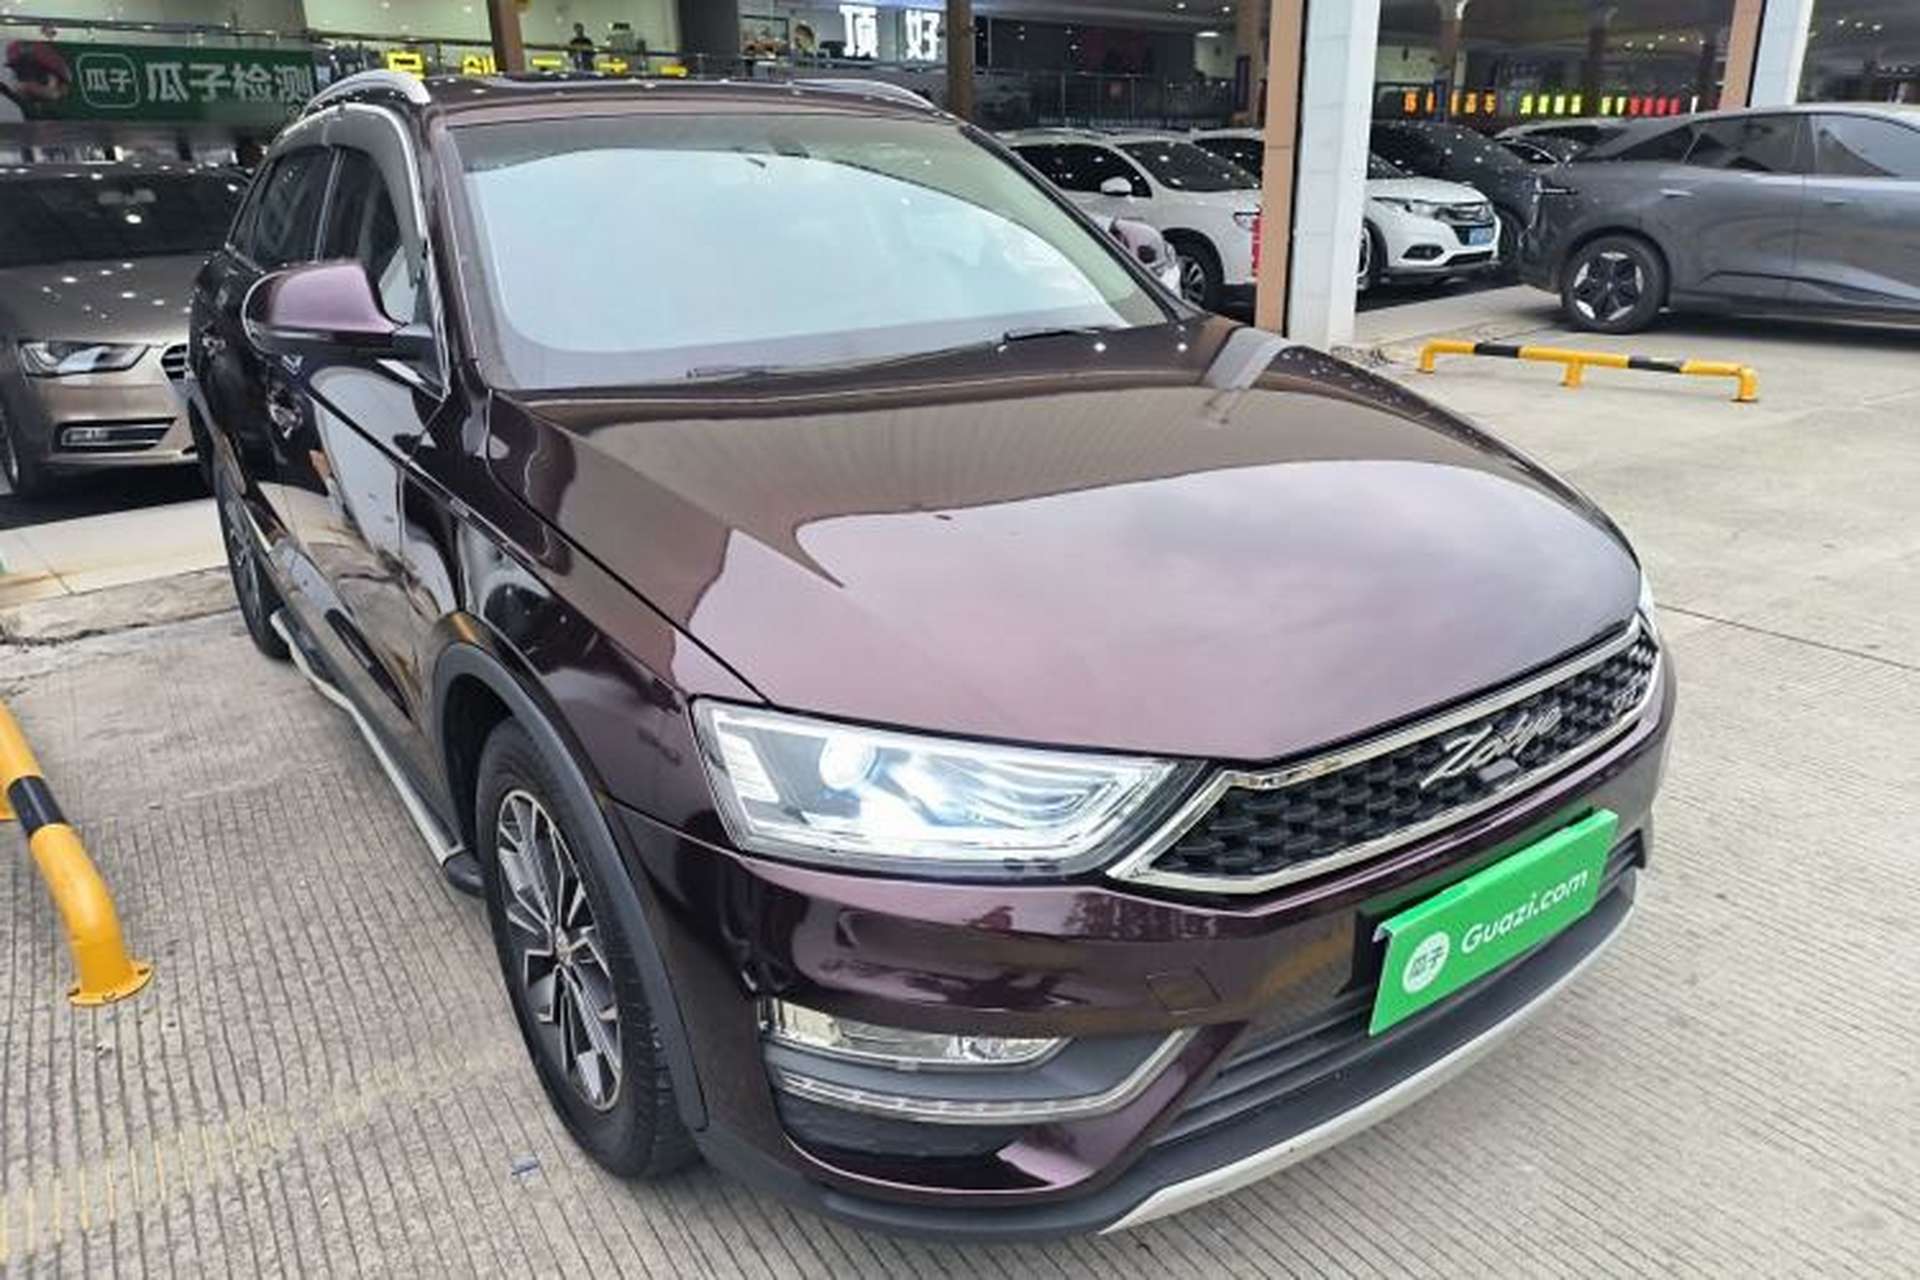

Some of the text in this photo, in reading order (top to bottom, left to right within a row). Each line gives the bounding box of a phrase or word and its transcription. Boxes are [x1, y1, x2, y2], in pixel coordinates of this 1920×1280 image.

[85, 67, 132, 93] 瓜子
[145, 62, 315, 103] 瓜子检测
[1460, 869, 1589, 954] Guazi.com
